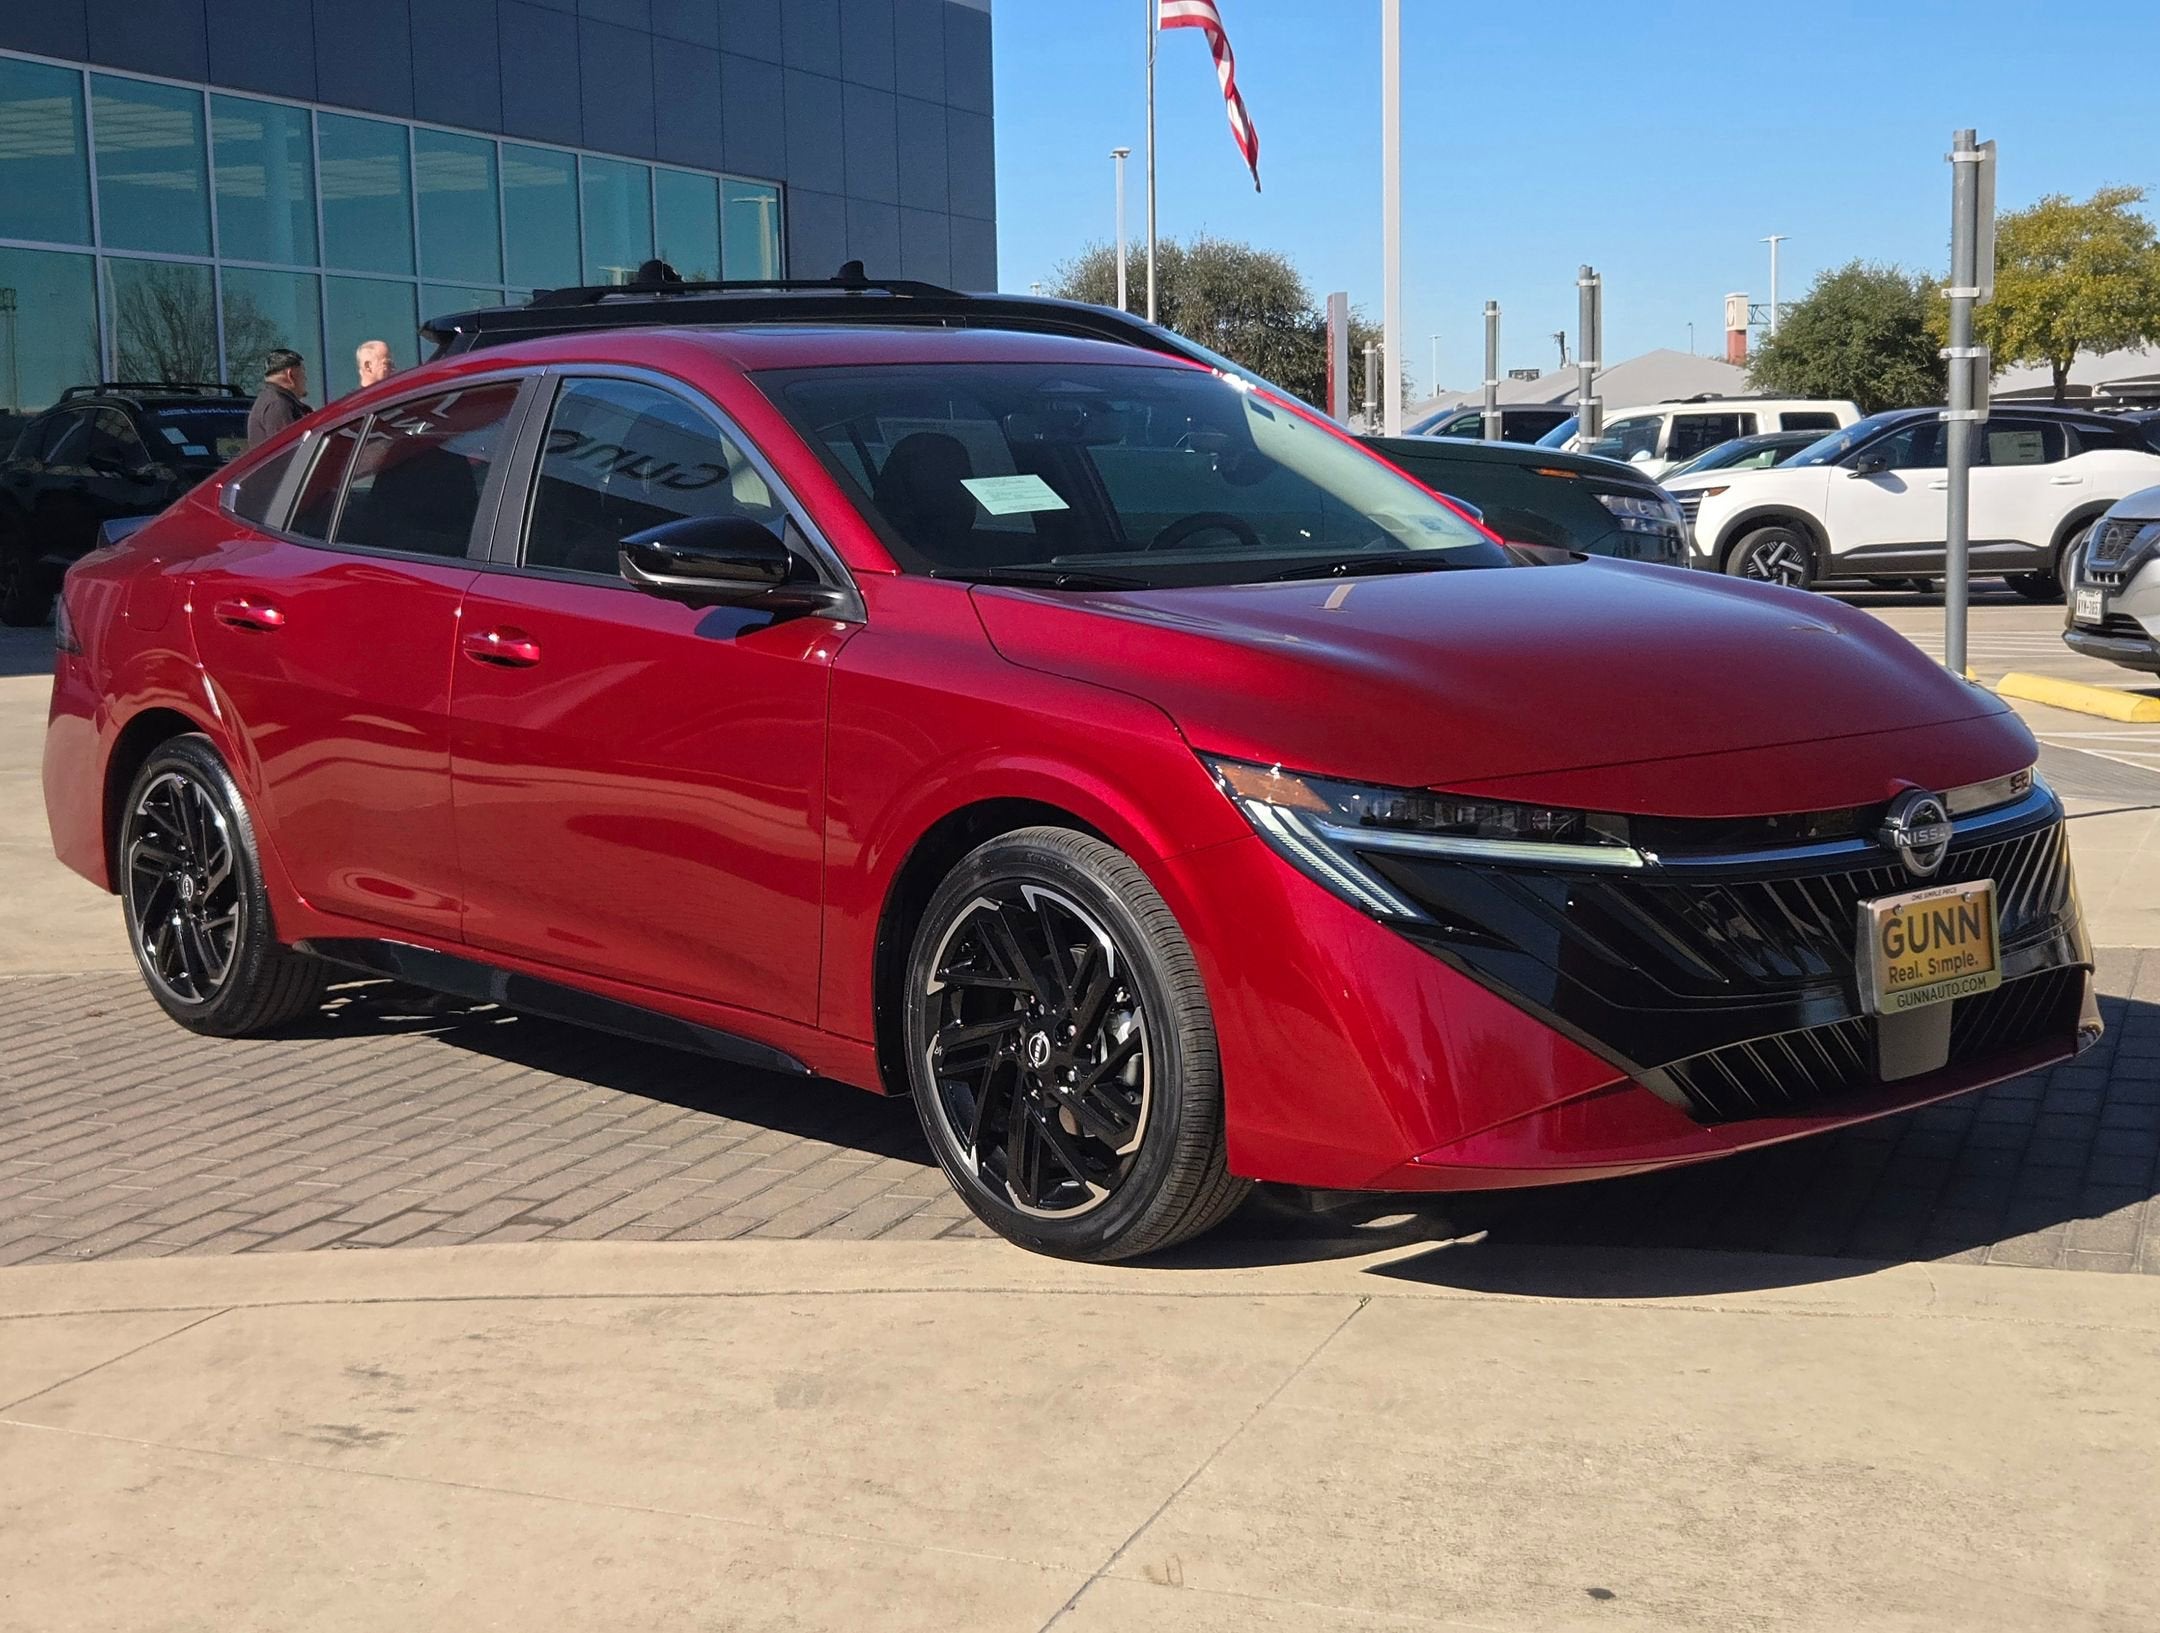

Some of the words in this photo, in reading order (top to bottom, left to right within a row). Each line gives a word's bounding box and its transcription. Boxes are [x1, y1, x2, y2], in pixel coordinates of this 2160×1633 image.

[1882, 903, 1981, 960] GUNN
[1888, 960, 1923, 985] Real.
[1928, 950, 1979, 976] Simple.
[1896, 976, 1988, 1009] GUNNAUTO.COM
